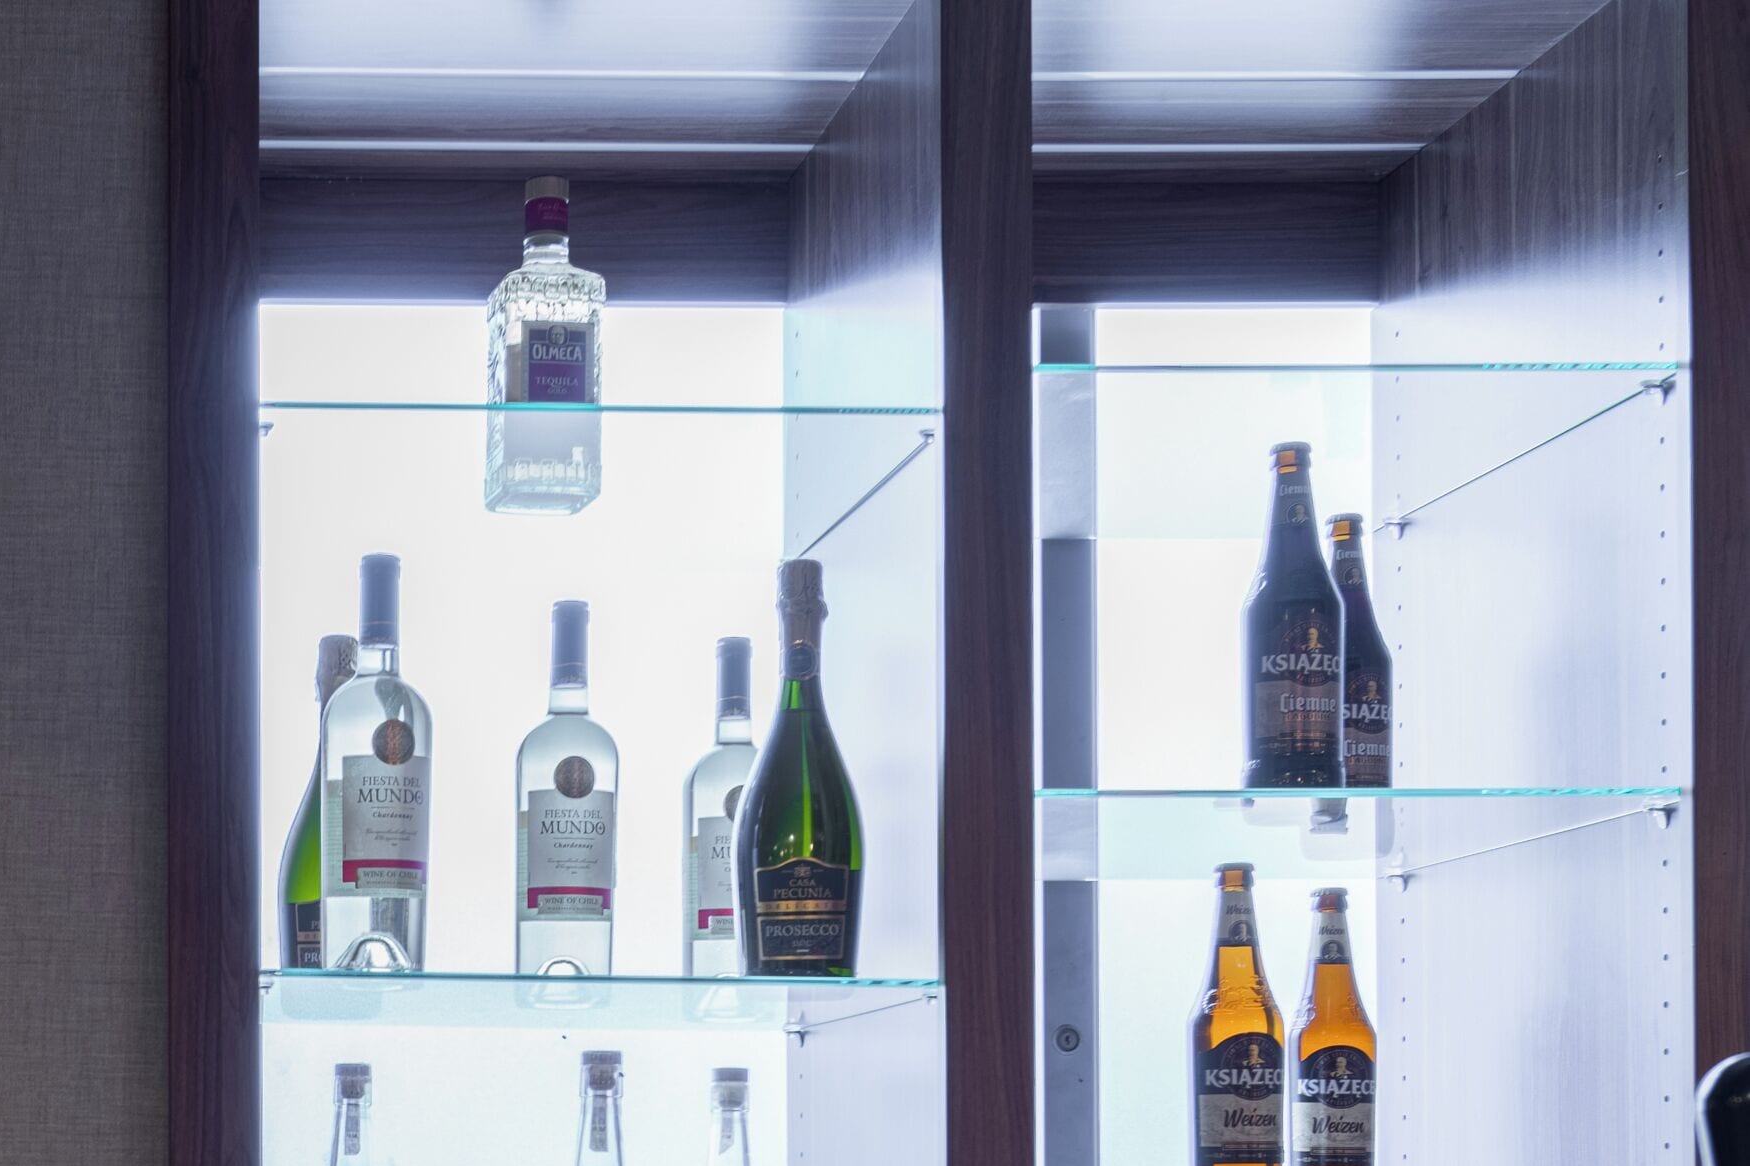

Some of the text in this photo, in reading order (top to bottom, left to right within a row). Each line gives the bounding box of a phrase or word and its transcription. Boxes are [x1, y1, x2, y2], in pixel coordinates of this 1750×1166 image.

[531, 343, 583, 362] OLMECA
[1261, 649, 1340, 675] KSIĄŻĘC
[362, 775, 421, 788] FIESTA DEL
[357, 788, 424, 805] MUNDO
[544, 808, 603, 819] FIESTA DEL
[540, 820, 606, 836] MUNDO
[553, 842, 594, 850] Chardonnay
[715, 836, 731, 844] FIE
[789, 879, 817, 887] CASA
[765, 924, 840, 937] PROSECCO
[1205, 1064, 1284, 1089] KSIĄŻĘC
[1223, 1108, 1277, 1128] Weizen
[1312, 1115, 1365, 1134] Weizen
